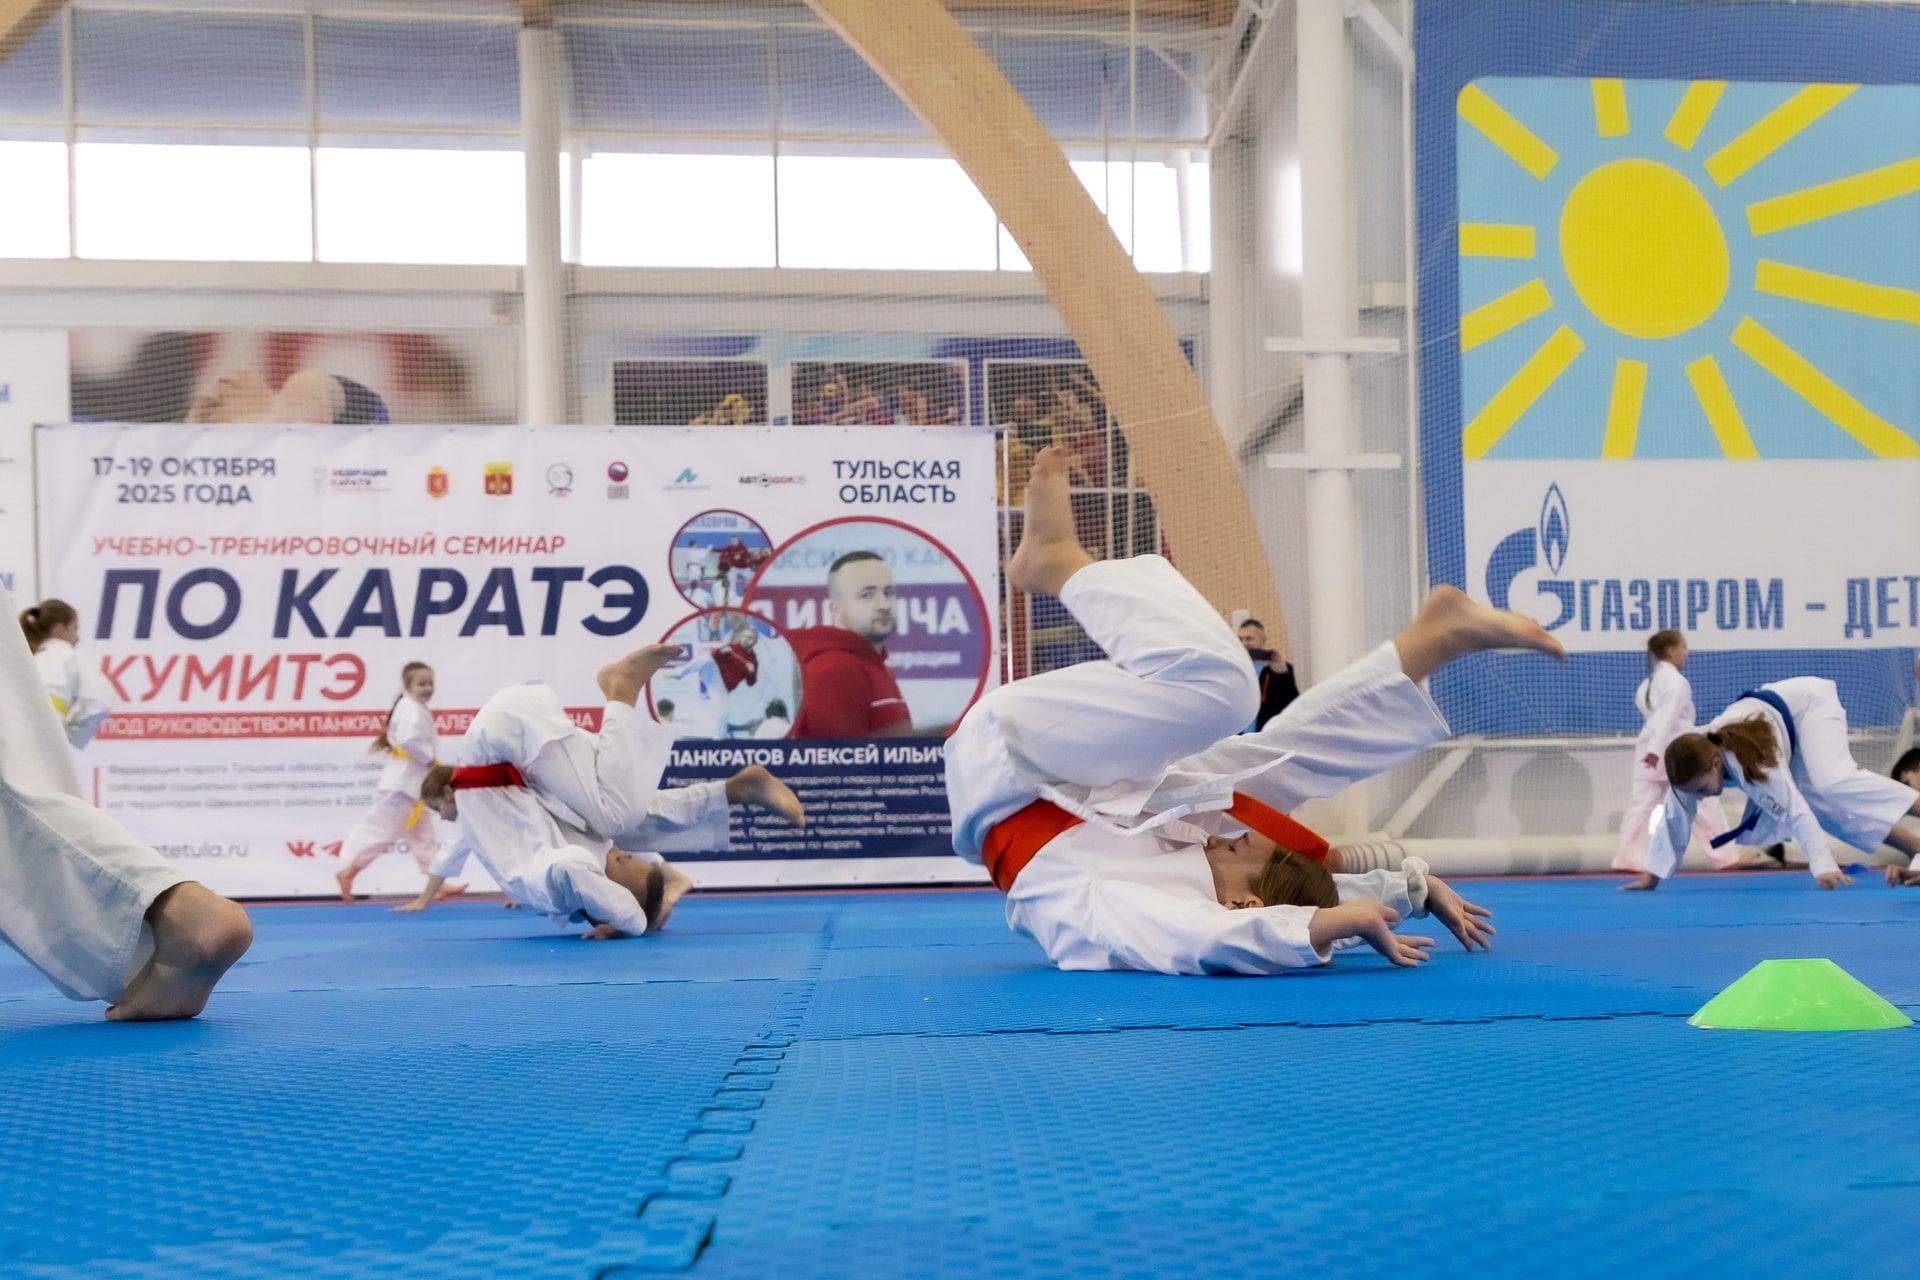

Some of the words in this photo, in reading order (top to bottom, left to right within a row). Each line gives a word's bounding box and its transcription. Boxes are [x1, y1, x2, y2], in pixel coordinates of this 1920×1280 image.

[160, 457, 276, 477] ОКТЯБРЯ
[832, 460, 961, 480] ТУЛЬСКАЯ
[117, 484, 176, 503] 2025
[184, 484, 253, 506] ГОДА
[838, 484, 957, 504] ОБЛАСТЬ
[93, 532, 437, 557] УЧЕБНО-ТРЕНИРОВОЧНЫЙ
[443, 535, 566, 556] СЕМИНАР
[95, 567, 242, 640] ПО
[272, 564, 650, 639] КАРАТЭ
[1580, 577, 1785, 633] ГАЗПРОМ
[101, 652, 367, 702] КУМИТЭ
[100, 717, 144, 737] ПОД
[147, 714, 304, 735] РУКОВОДСТВОМ
[666, 747, 785, 768] ПАНКРАТОВ
[788, 743, 880, 766] АЛЕКСЕЙ
